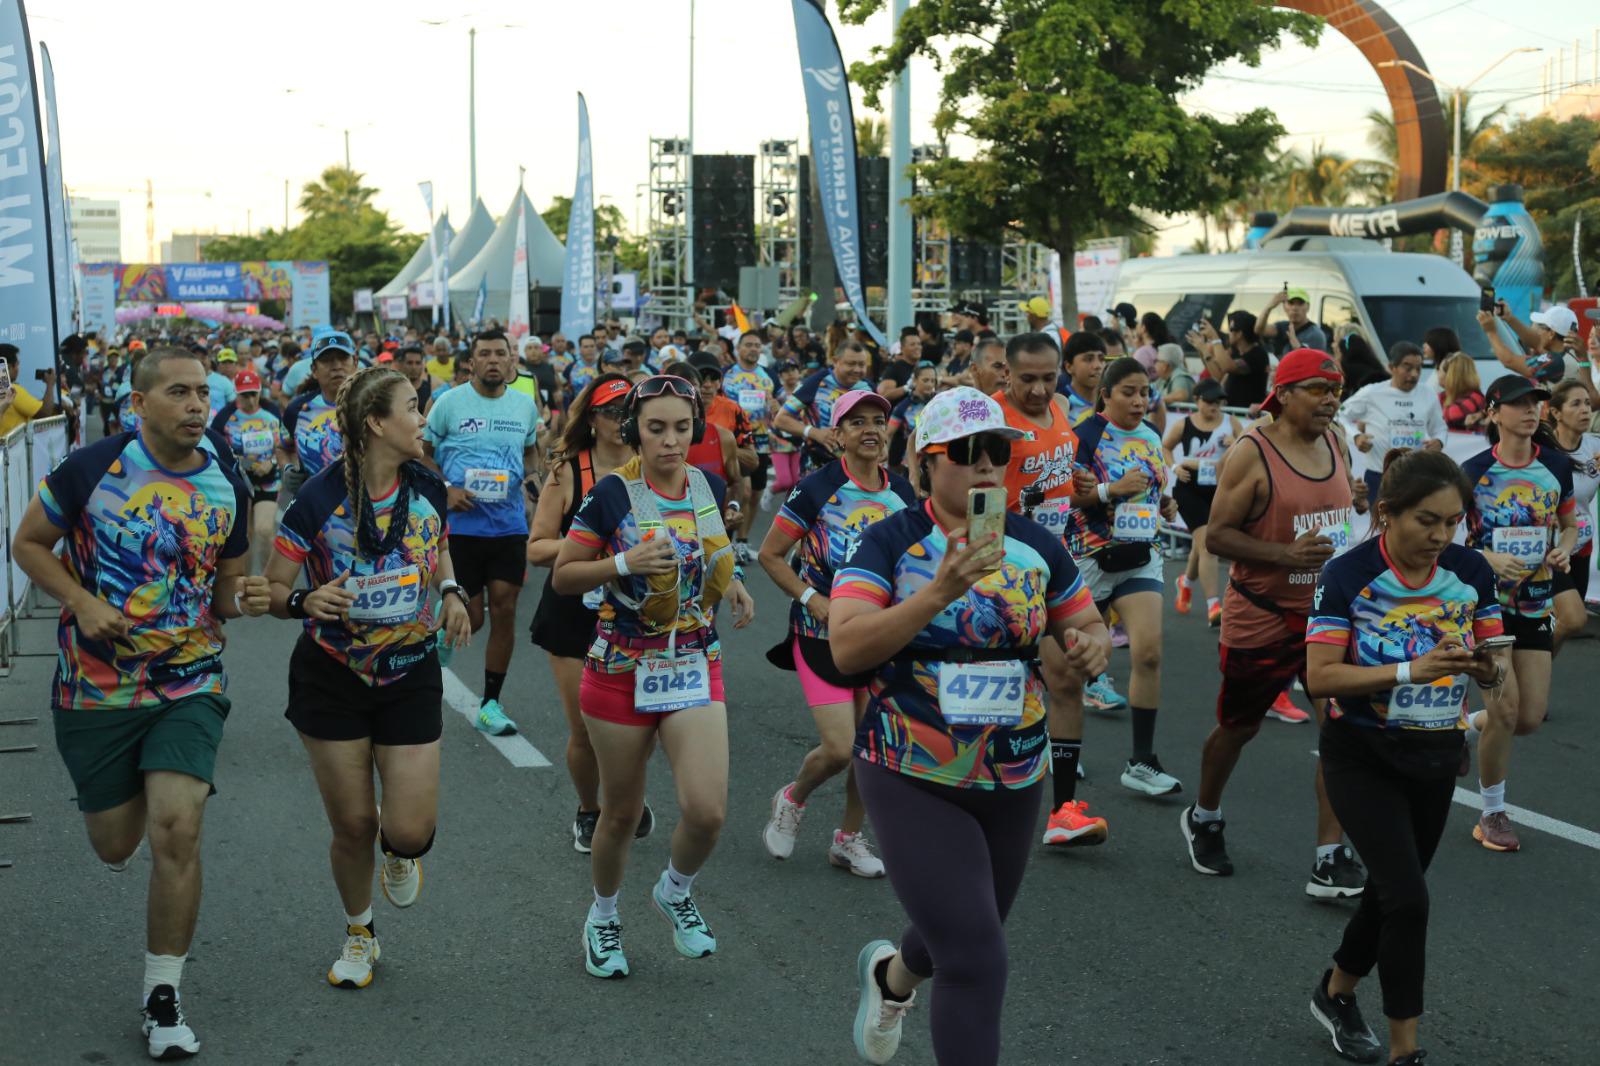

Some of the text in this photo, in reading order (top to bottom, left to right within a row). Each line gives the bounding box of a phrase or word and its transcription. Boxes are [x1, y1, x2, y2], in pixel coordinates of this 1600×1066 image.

[1330, 209, 1400, 237] META
[178, 284, 229, 296] SALIDA
[1024, 441, 1073, 471] BALAM
[469, 480, 504, 492] 4721
[1036, 472, 1073, 492] NNERS
[1496, 540, 1544, 556] 5634
[1289, 573, 1313, 584] GOOD
[353, 583, 417, 609] 4973
[643, 670, 703, 694] 6142
[946, 674, 1021, 701] 4773
[1395, 684, 1465, 708] 6429
